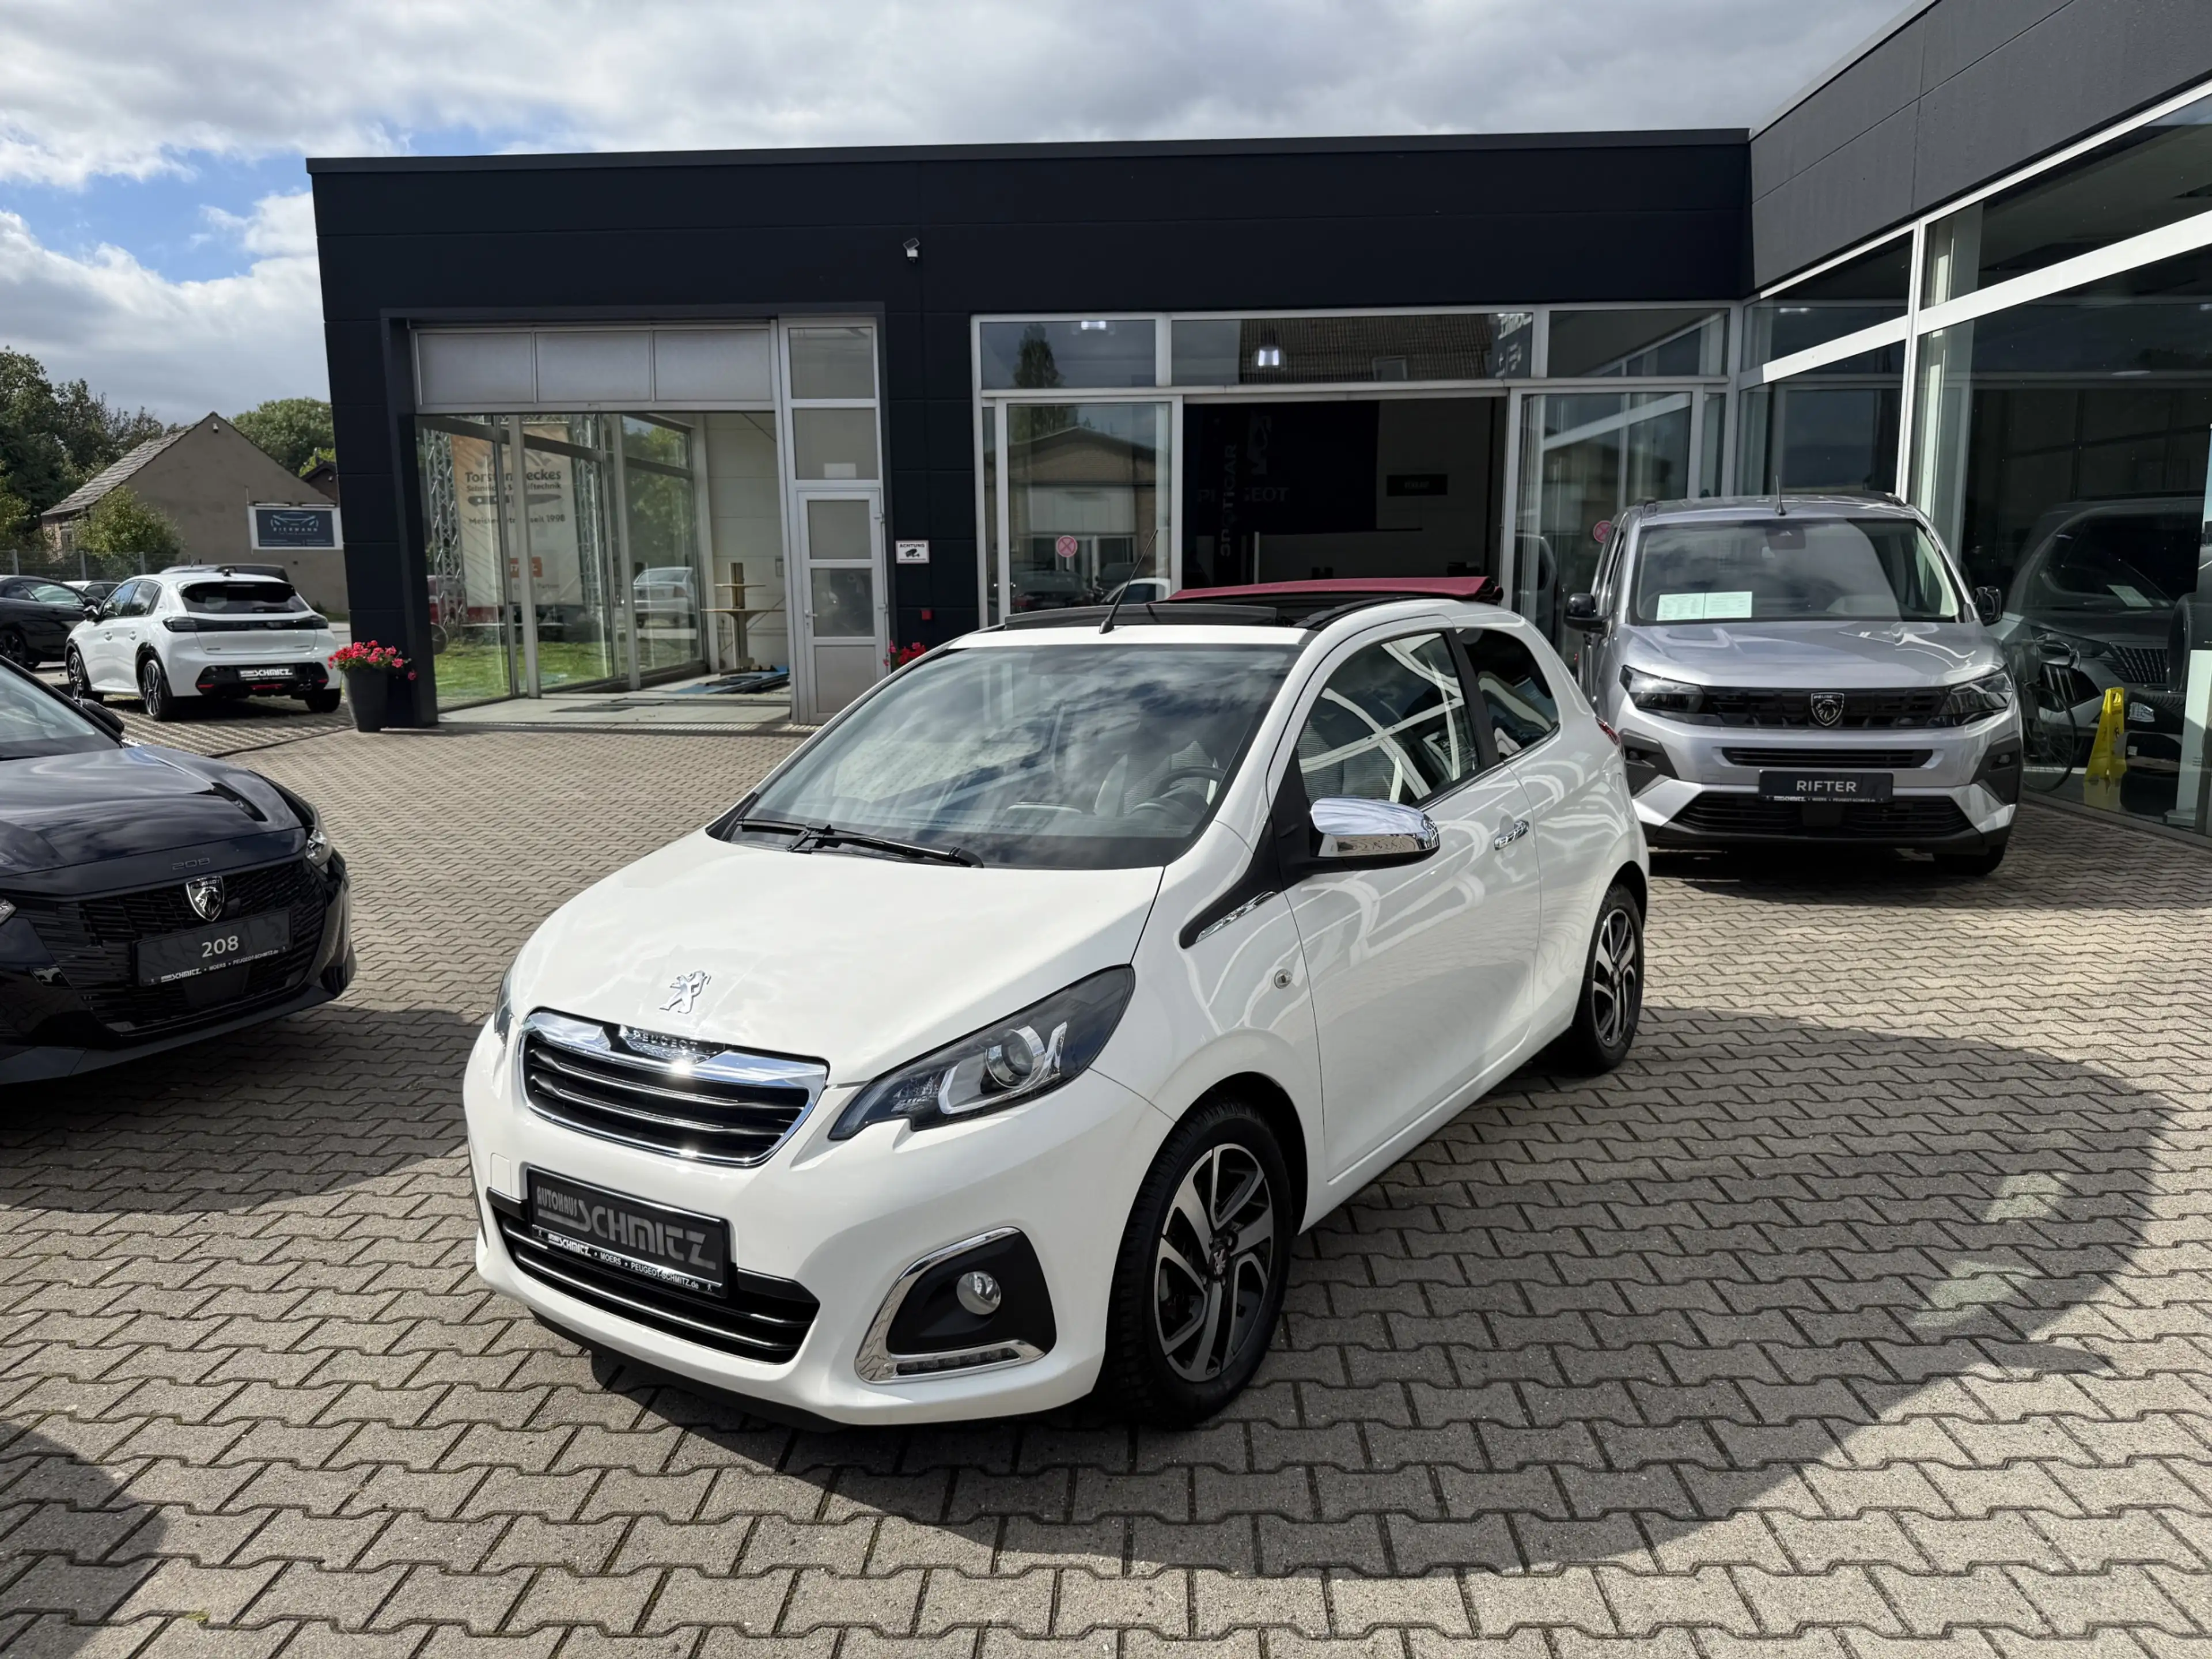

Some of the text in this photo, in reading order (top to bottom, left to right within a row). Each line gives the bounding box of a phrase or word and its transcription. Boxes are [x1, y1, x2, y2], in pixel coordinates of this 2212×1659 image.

[525, 469, 562, 481] eckes
[1796, 780, 1857, 793] RIFTER
[172, 857, 210, 870] 208
[202, 935, 239, 958] 208
[633, 1029, 698, 1052] PEUGEOT
[536, 1185, 717, 1271] AUTOHAUS SCHMITZ
[600, 1252, 622, 1266] MOERS
[631, 1261, 699, 1290] PEUGEOT-SCHMITZ.de
